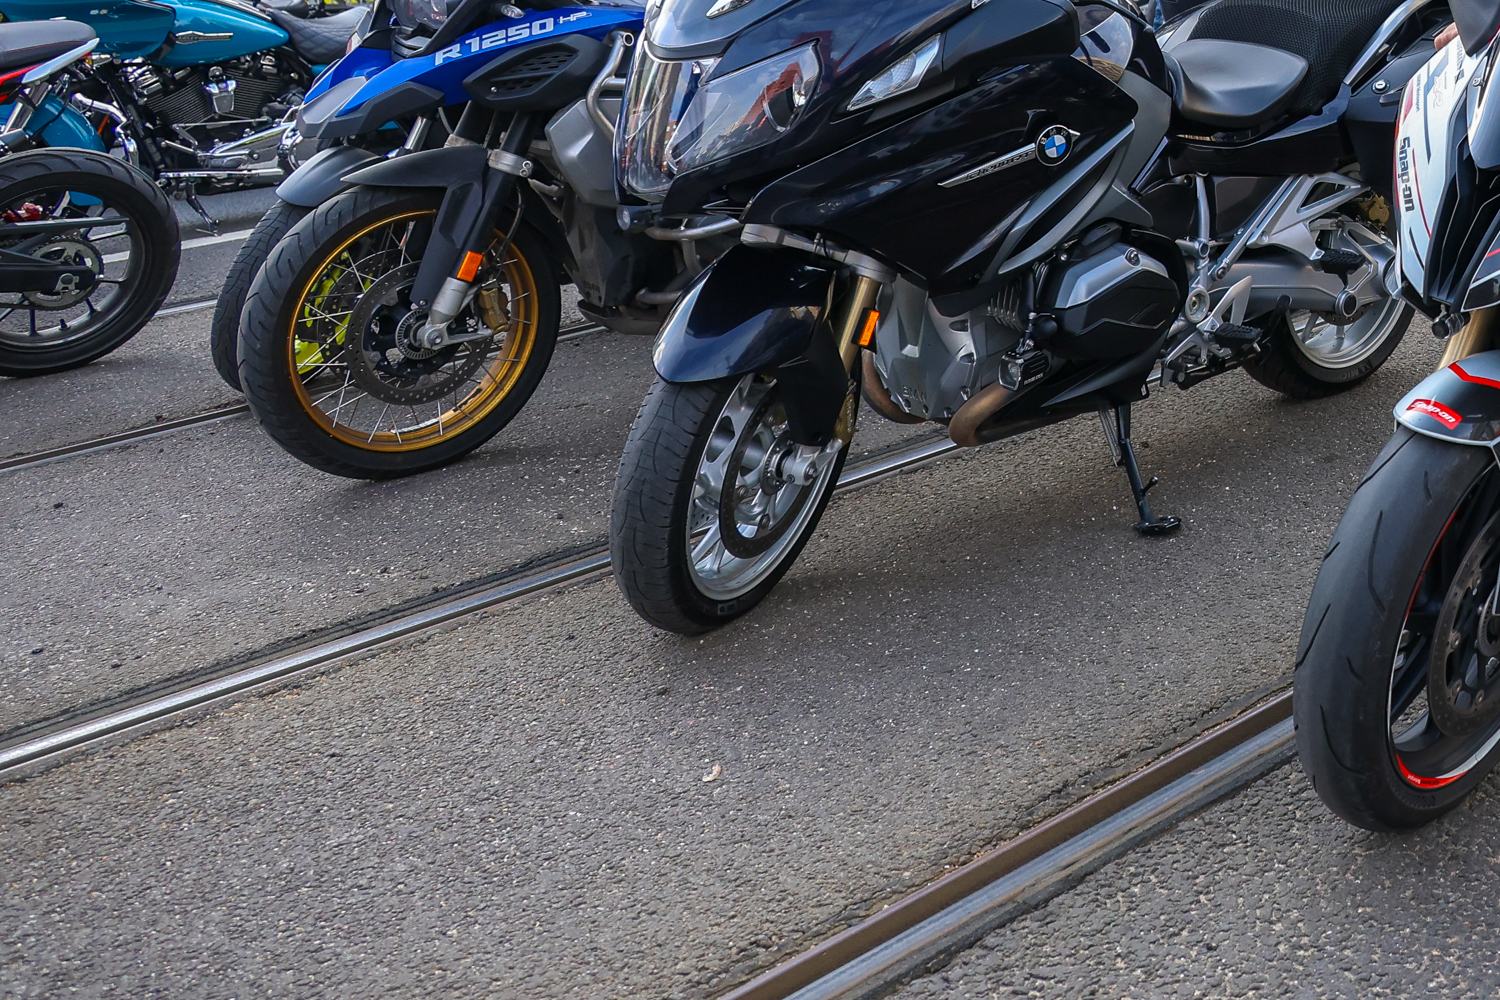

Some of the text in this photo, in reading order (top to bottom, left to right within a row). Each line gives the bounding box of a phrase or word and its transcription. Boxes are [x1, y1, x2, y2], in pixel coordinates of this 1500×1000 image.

[435, 42, 461, 66] R
[465, 17, 555, 53] 1250
[1397, 136, 1416, 213] Snap-on
[1411, 400, 1457, 424] Snap-on
